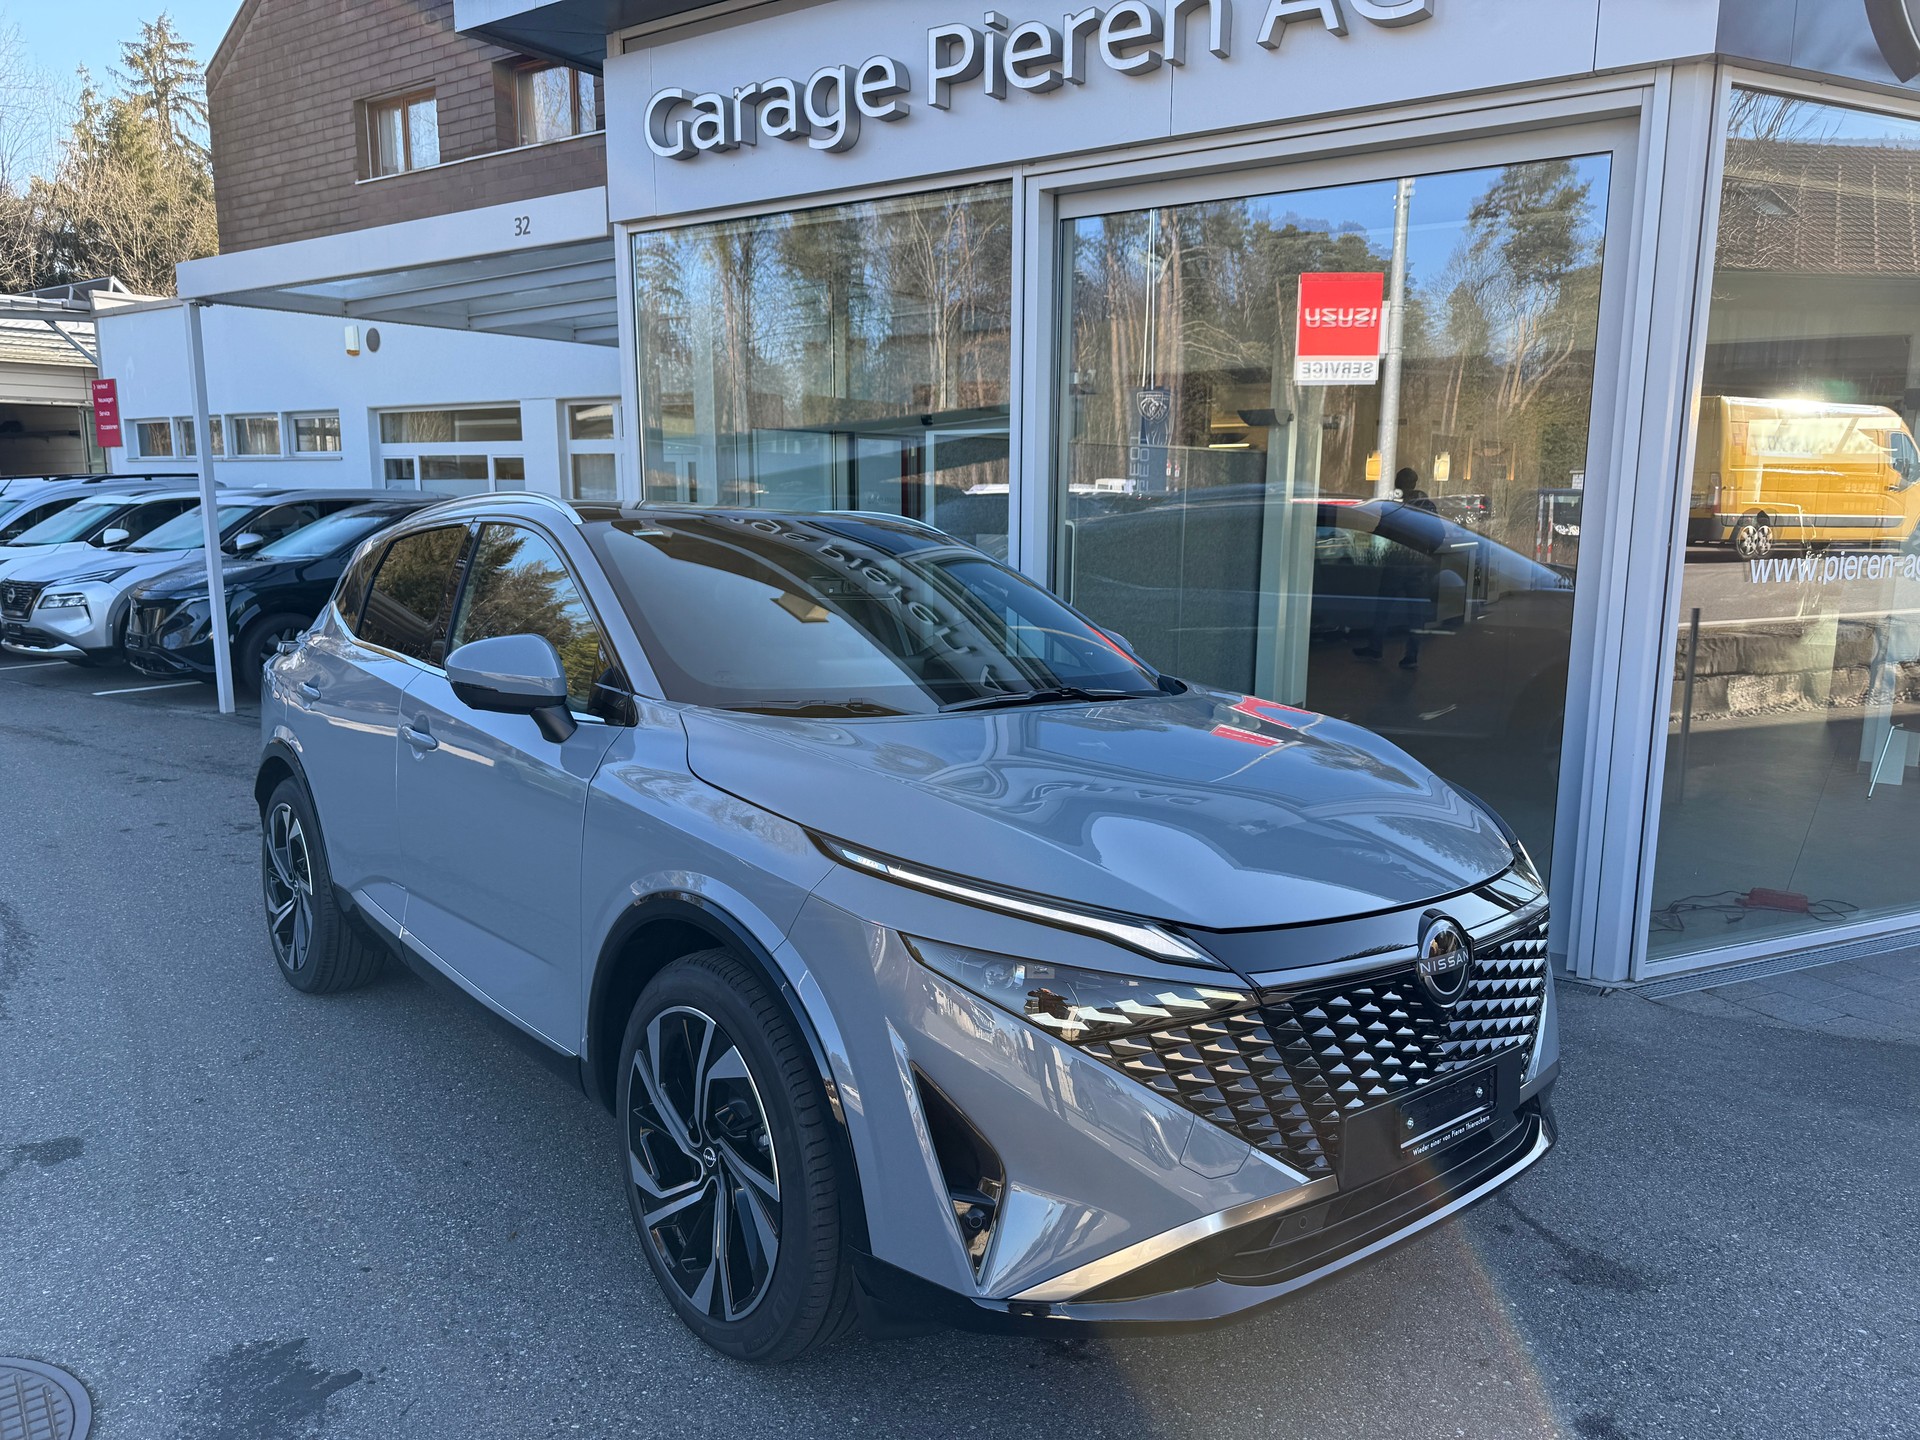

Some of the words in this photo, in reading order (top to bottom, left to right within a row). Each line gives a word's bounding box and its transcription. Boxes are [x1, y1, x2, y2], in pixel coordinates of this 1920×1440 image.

[643, 55, 910, 160] Garage
[927, 0, 1232, 109] Pieren
[514, 215, 531, 237] 32
[1420, 951, 1469, 974] NISSAN
[1412, 1143, 1430, 1156] Wieder
[1430, 1138, 1441, 1148] einer
[1442, 1134, 1451, 1142] von
[1451, 1127, 1465, 1138] Pieren
